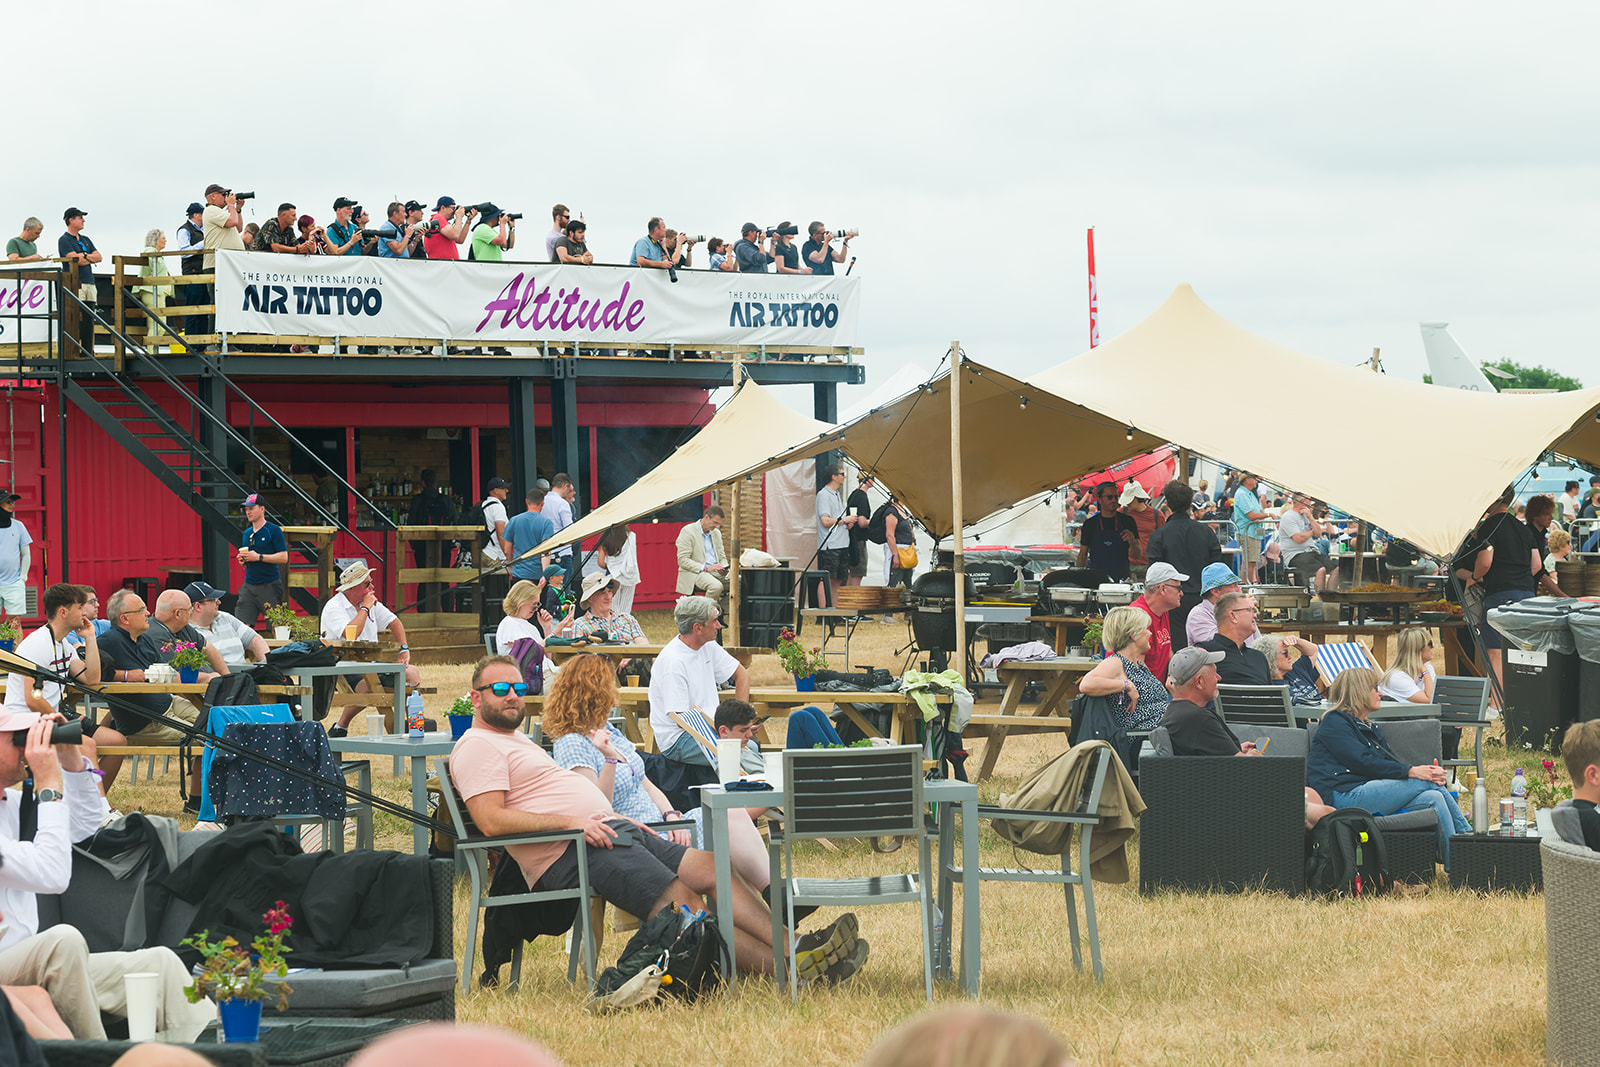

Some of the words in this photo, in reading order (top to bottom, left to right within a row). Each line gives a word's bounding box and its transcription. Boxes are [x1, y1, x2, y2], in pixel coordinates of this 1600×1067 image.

[242, 272, 260, 282] THE
[266, 273, 297, 283] ROYAL
[302, 275, 383, 286] INTERNATIONAL
[242, 284, 289, 315] AIR
[292, 286, 383, 317] TATTOO
[475, 271, 646, 333] Altitude
[728, 291, 743, 300] THE
[747, 291, 772, 301] ROYAL
[776, 292, 840, 301] INTERNATIONAL
[729, 301, 766, 328] AIR
[768, 302, 839, 329] TATTOO
